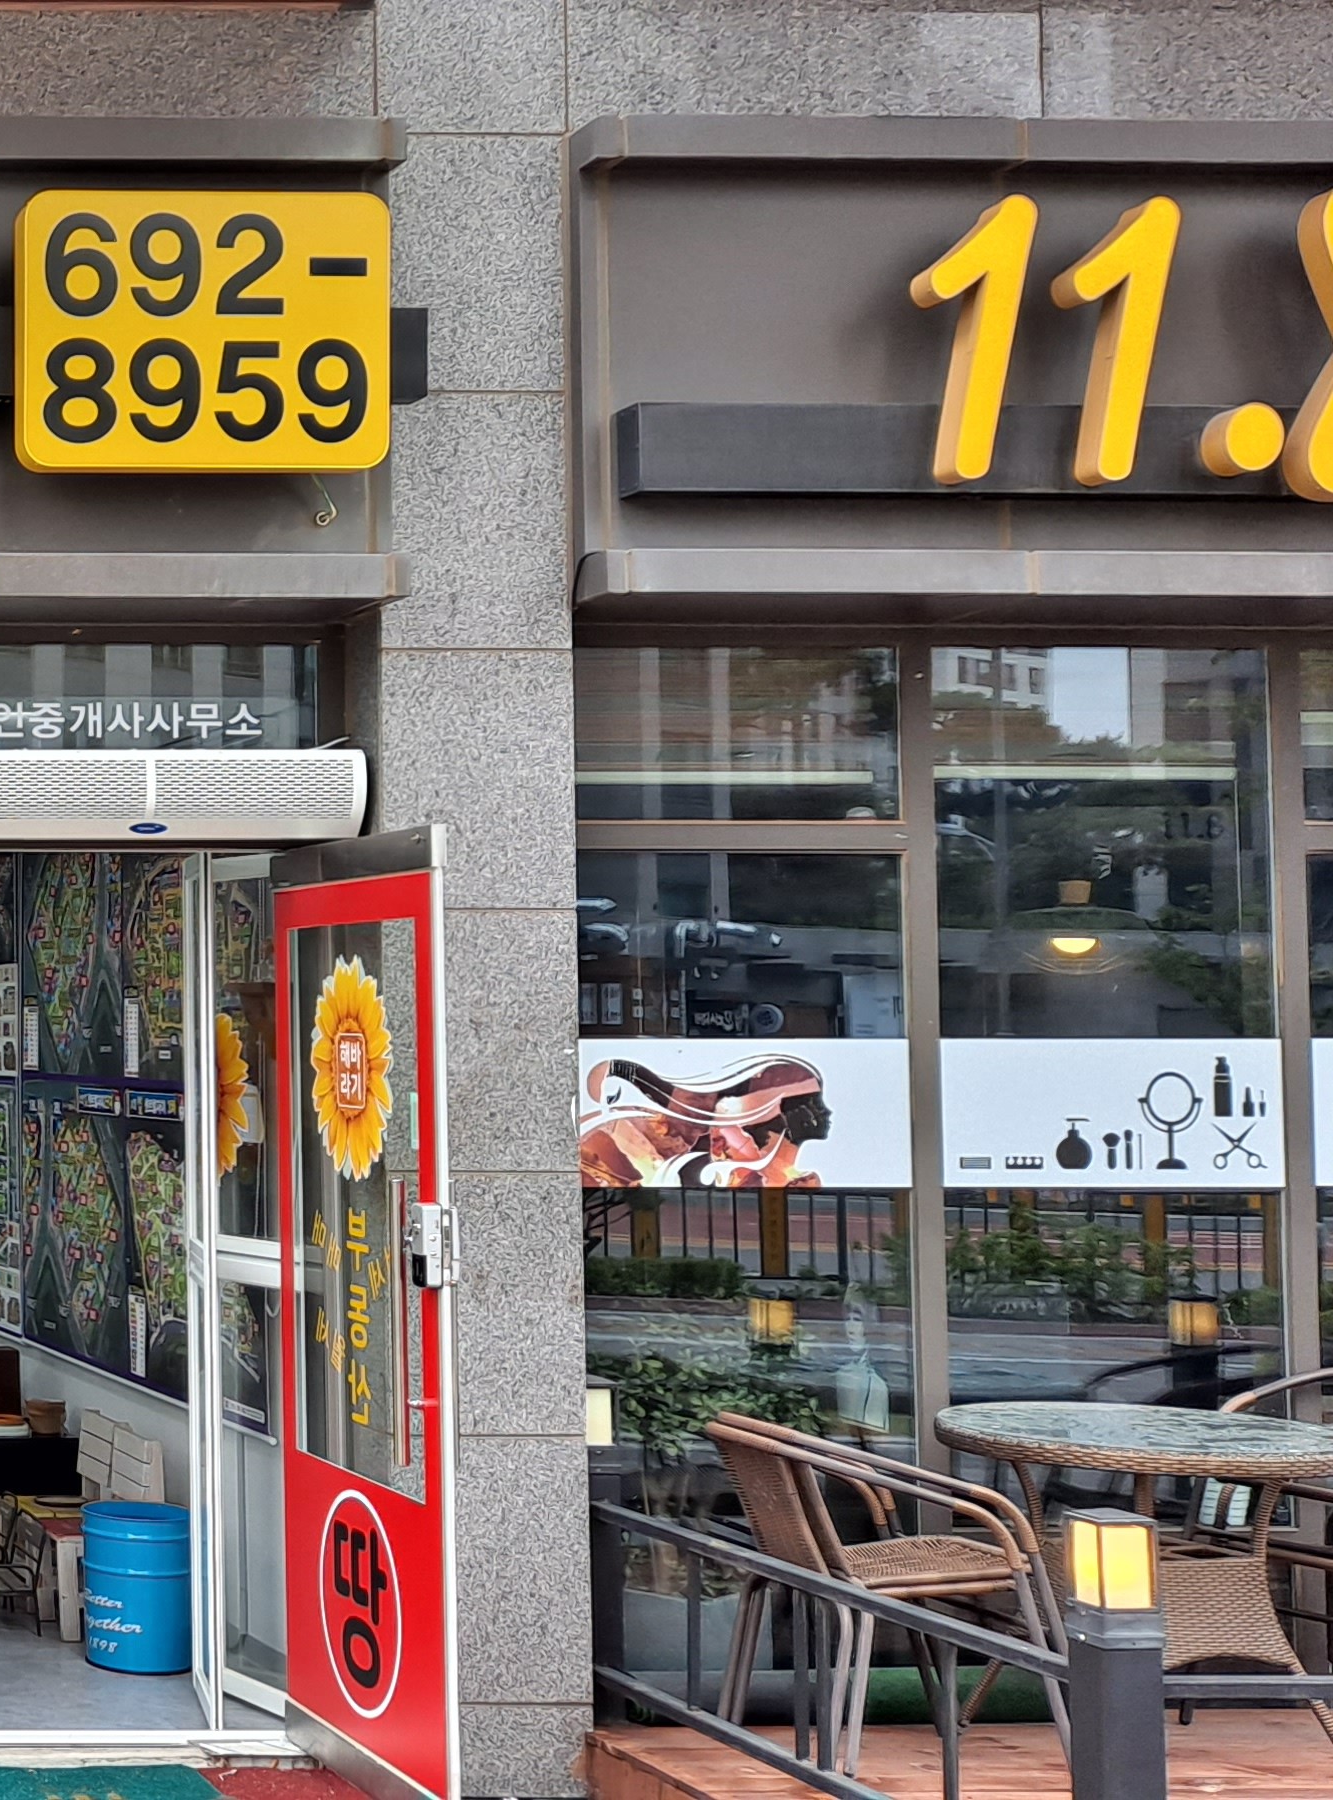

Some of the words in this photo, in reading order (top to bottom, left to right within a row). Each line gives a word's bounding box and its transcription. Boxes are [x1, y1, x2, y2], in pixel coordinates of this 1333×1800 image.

[43, 211, 369, 318] 692-
[45, 337, 370, 446] 8959
[333, 1520, 387, 1688] 땅
